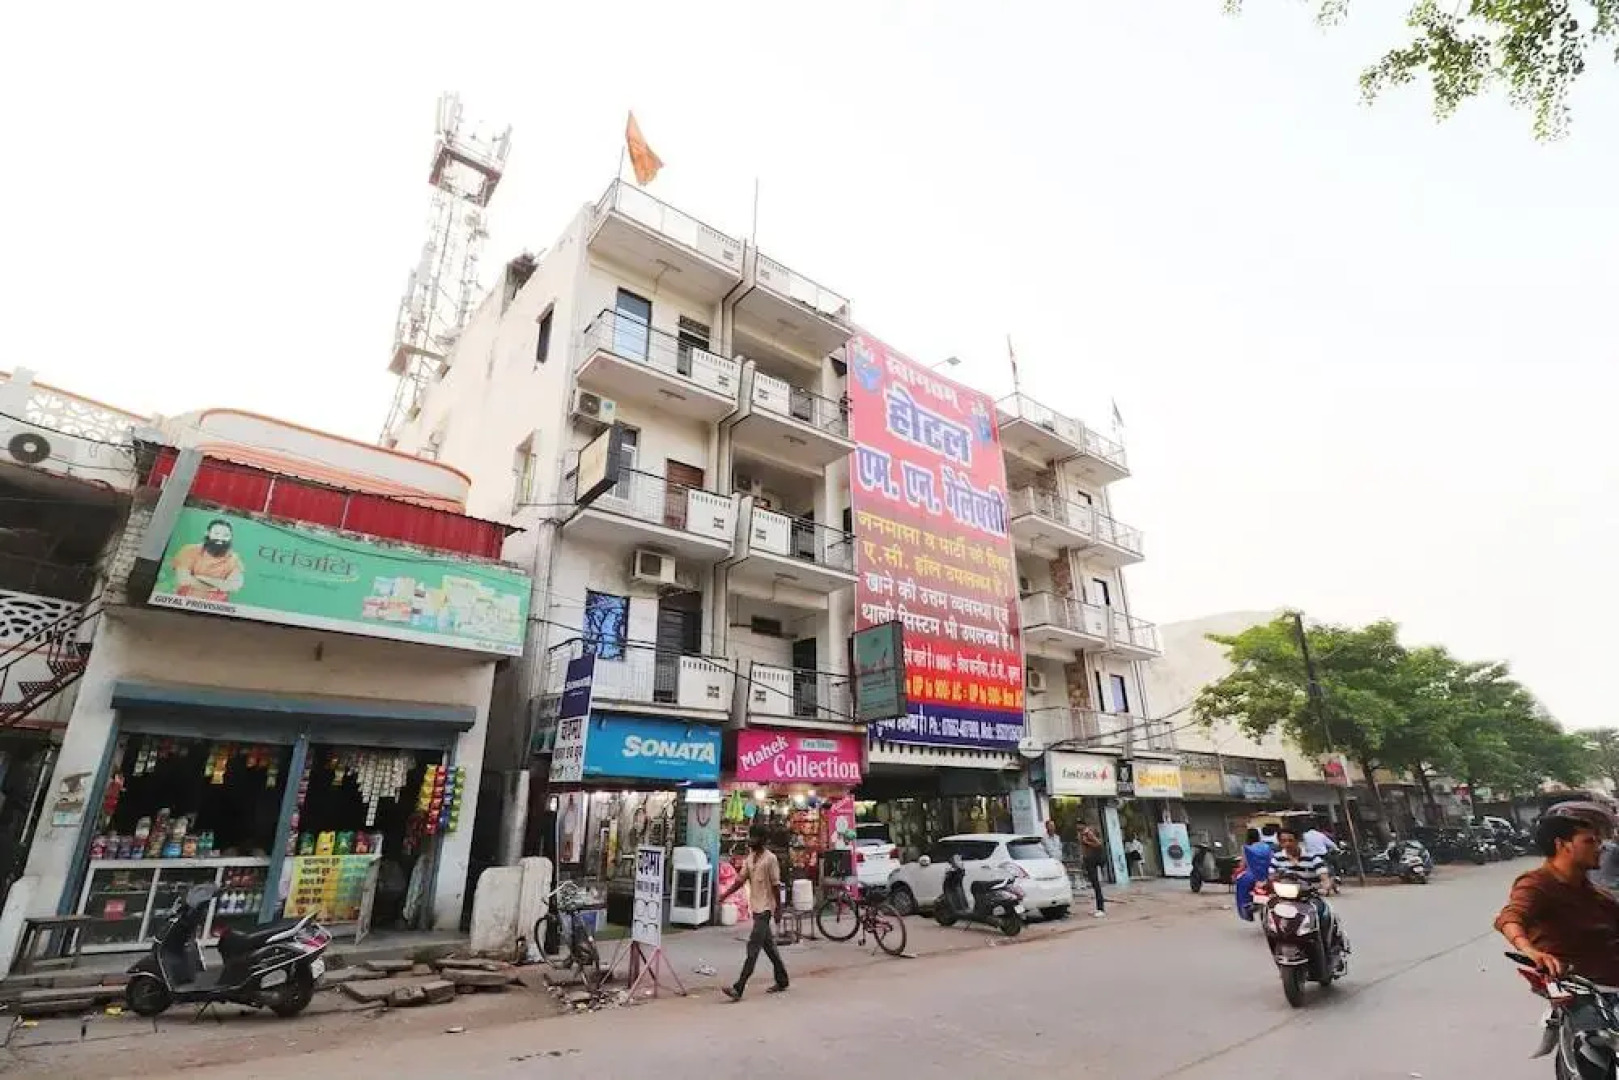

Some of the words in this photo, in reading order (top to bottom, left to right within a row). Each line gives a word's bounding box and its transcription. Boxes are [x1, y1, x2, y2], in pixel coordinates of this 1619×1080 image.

[884, 381, 973, 467] होटल
[864, 570, 894, 597] खाने
[897, 577, 917, 601] की
[154, 595, 183, 606] GOYAL
[185, 600, 236, 614] PROVISIONS
[897, 603, 940, 635] सिस्टम
[944, 614, 958, 640] भी
[959, 622, 1000, 646] उपलब्ध
[622, 734, 716, 765] SONATA
[740, 735, 789, 771] Mahek
[773, 754, 861, 779] Collection
[1062, 766, 1097, 780] fastrack
